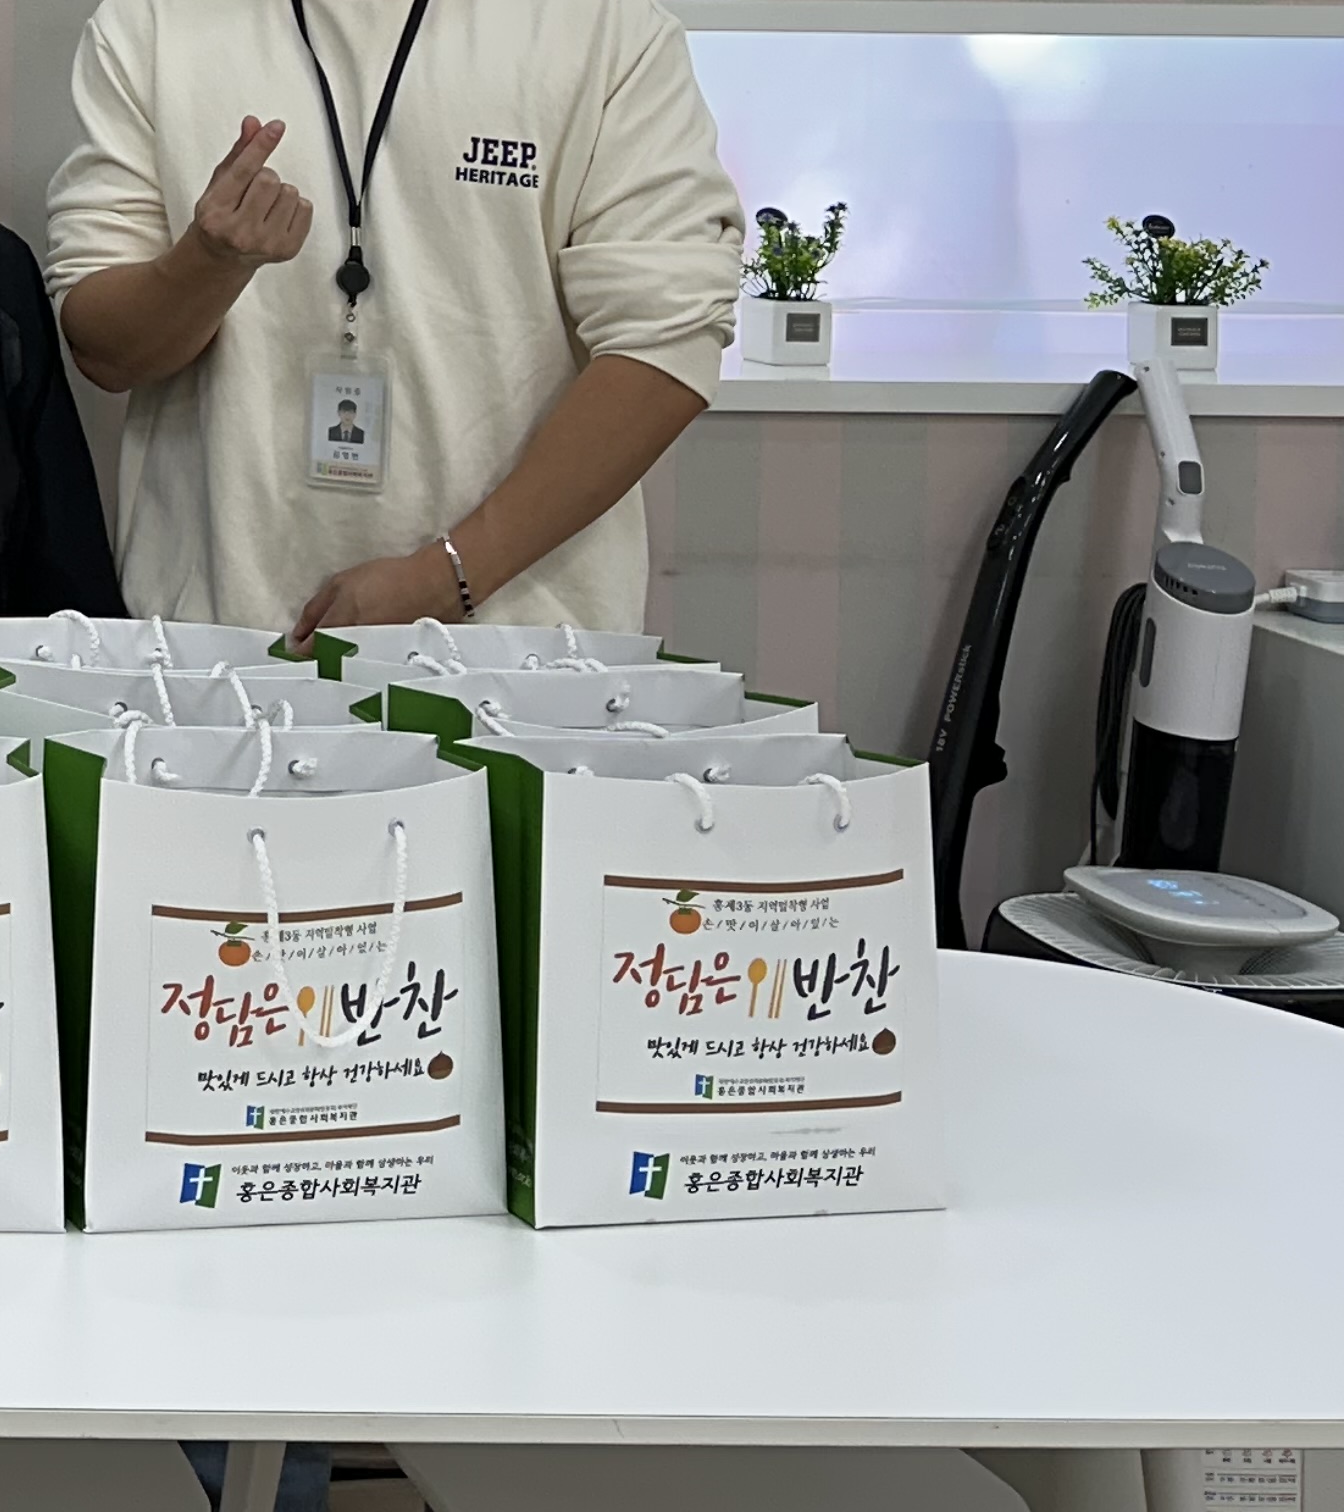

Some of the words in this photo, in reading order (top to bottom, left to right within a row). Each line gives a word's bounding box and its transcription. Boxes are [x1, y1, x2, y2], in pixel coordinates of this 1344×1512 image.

[462, 136, 537, 169] JEEP
[455, 166, 540, 188] HERITAGE
[810, 896, 830, 911] 사업
[356, 921, 377, 936] 사업
[612, 943, 742, 1016] 정담은
[793, 937, 901, 1021] 반찬
[161, 974, 289, 1048] 정담은
[340, 960, 459, 1047] 반찬
[647, 1038, 699, 1059] 맛있게
[705, 1039, 746, 1058] 드시고
[751, 1036, 788, 1060] 항상
[792, 1033, 870, 1058] 건강하세요
[197, 1069, 250, 1093] 맛있게
[256, 1069, 296, 1087] 드시고
[302, 1065, 338, 1087] 항상
[343, 1057, 425, 1085] 건강하세요
[236, 1173, 422, 1204] 홍은종합사회복지관
[684, 1165, 864, 1195] 홍은종합사회복지관
